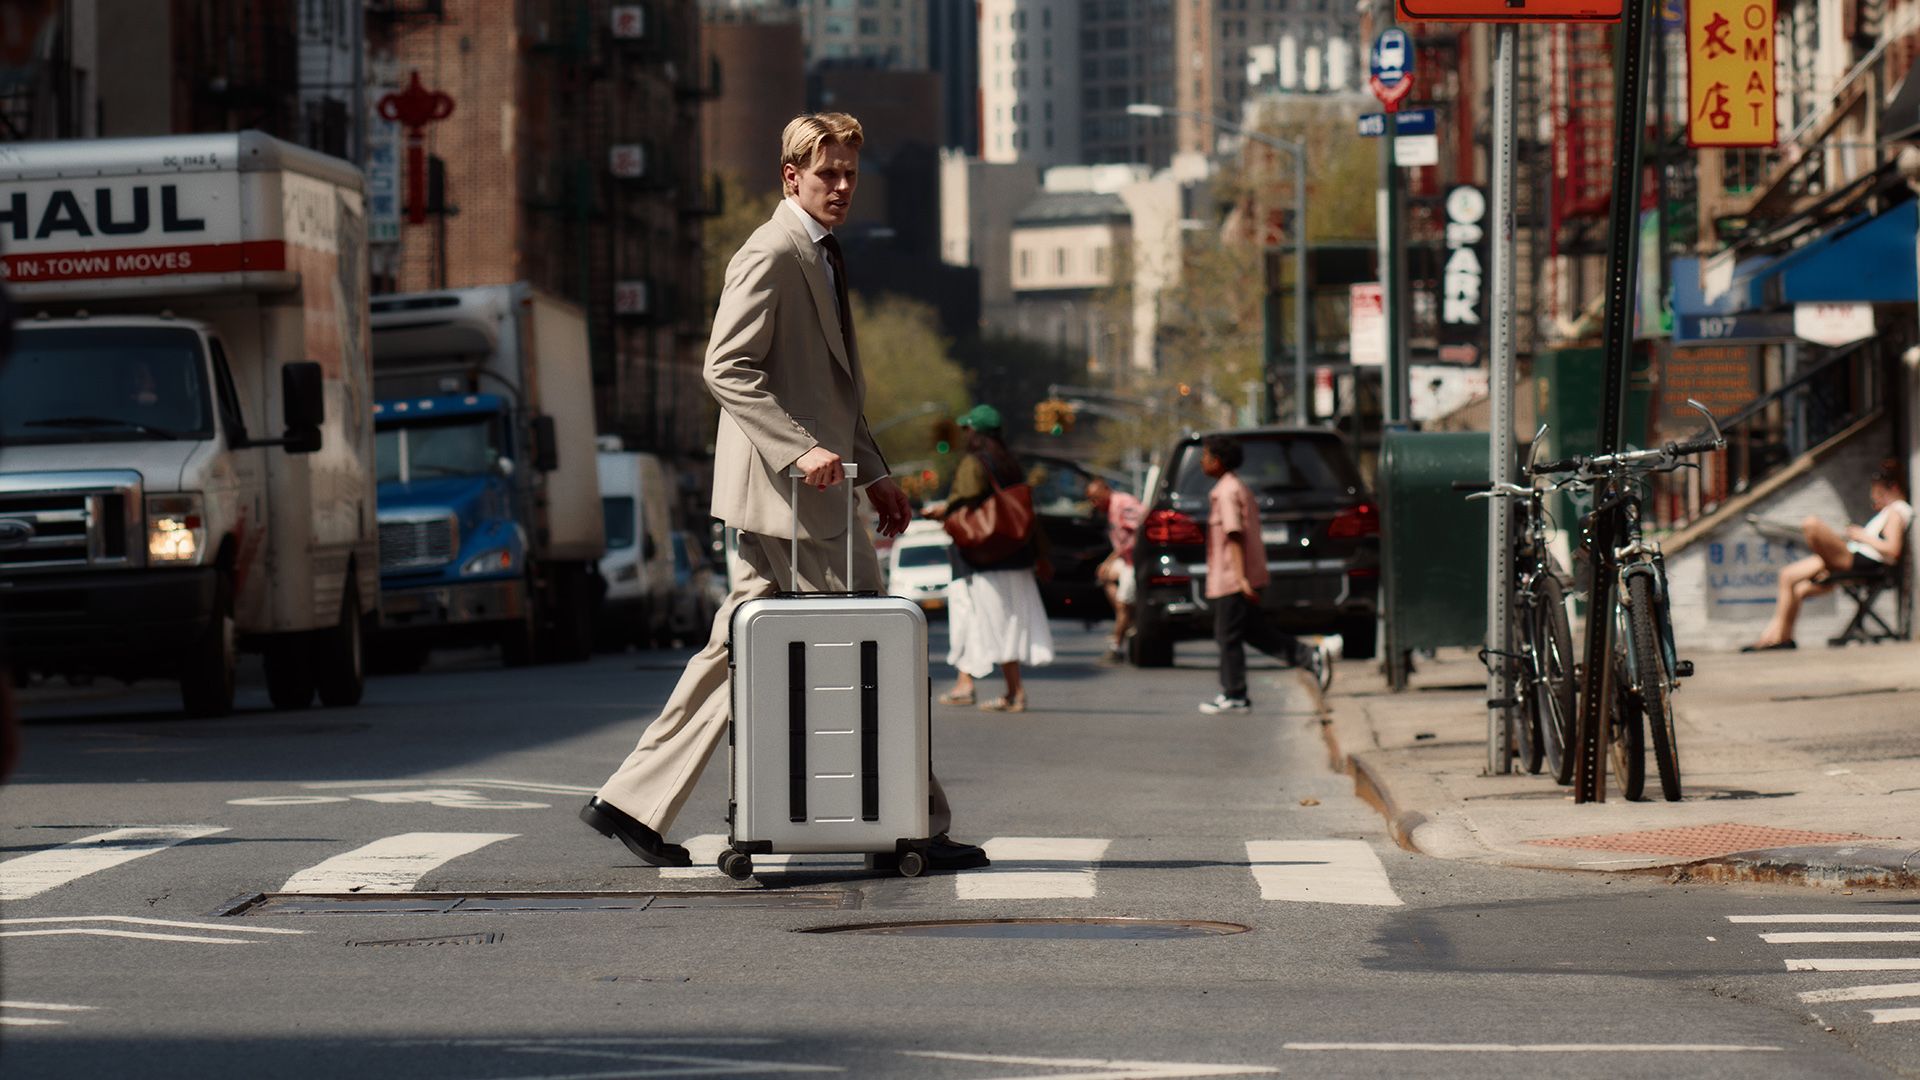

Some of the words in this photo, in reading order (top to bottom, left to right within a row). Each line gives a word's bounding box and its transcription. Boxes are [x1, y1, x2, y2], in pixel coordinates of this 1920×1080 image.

[1698, 12, 1736, 130] 衣店
[1744, 4, 1768, 127] OMAT
[17, 255, 110, 276] IN-TOWN
[116, 251, 192, 272] MOVES
[1443, 223, 1483, 324] PARK
[1699, 317, 1737, 337] 107
